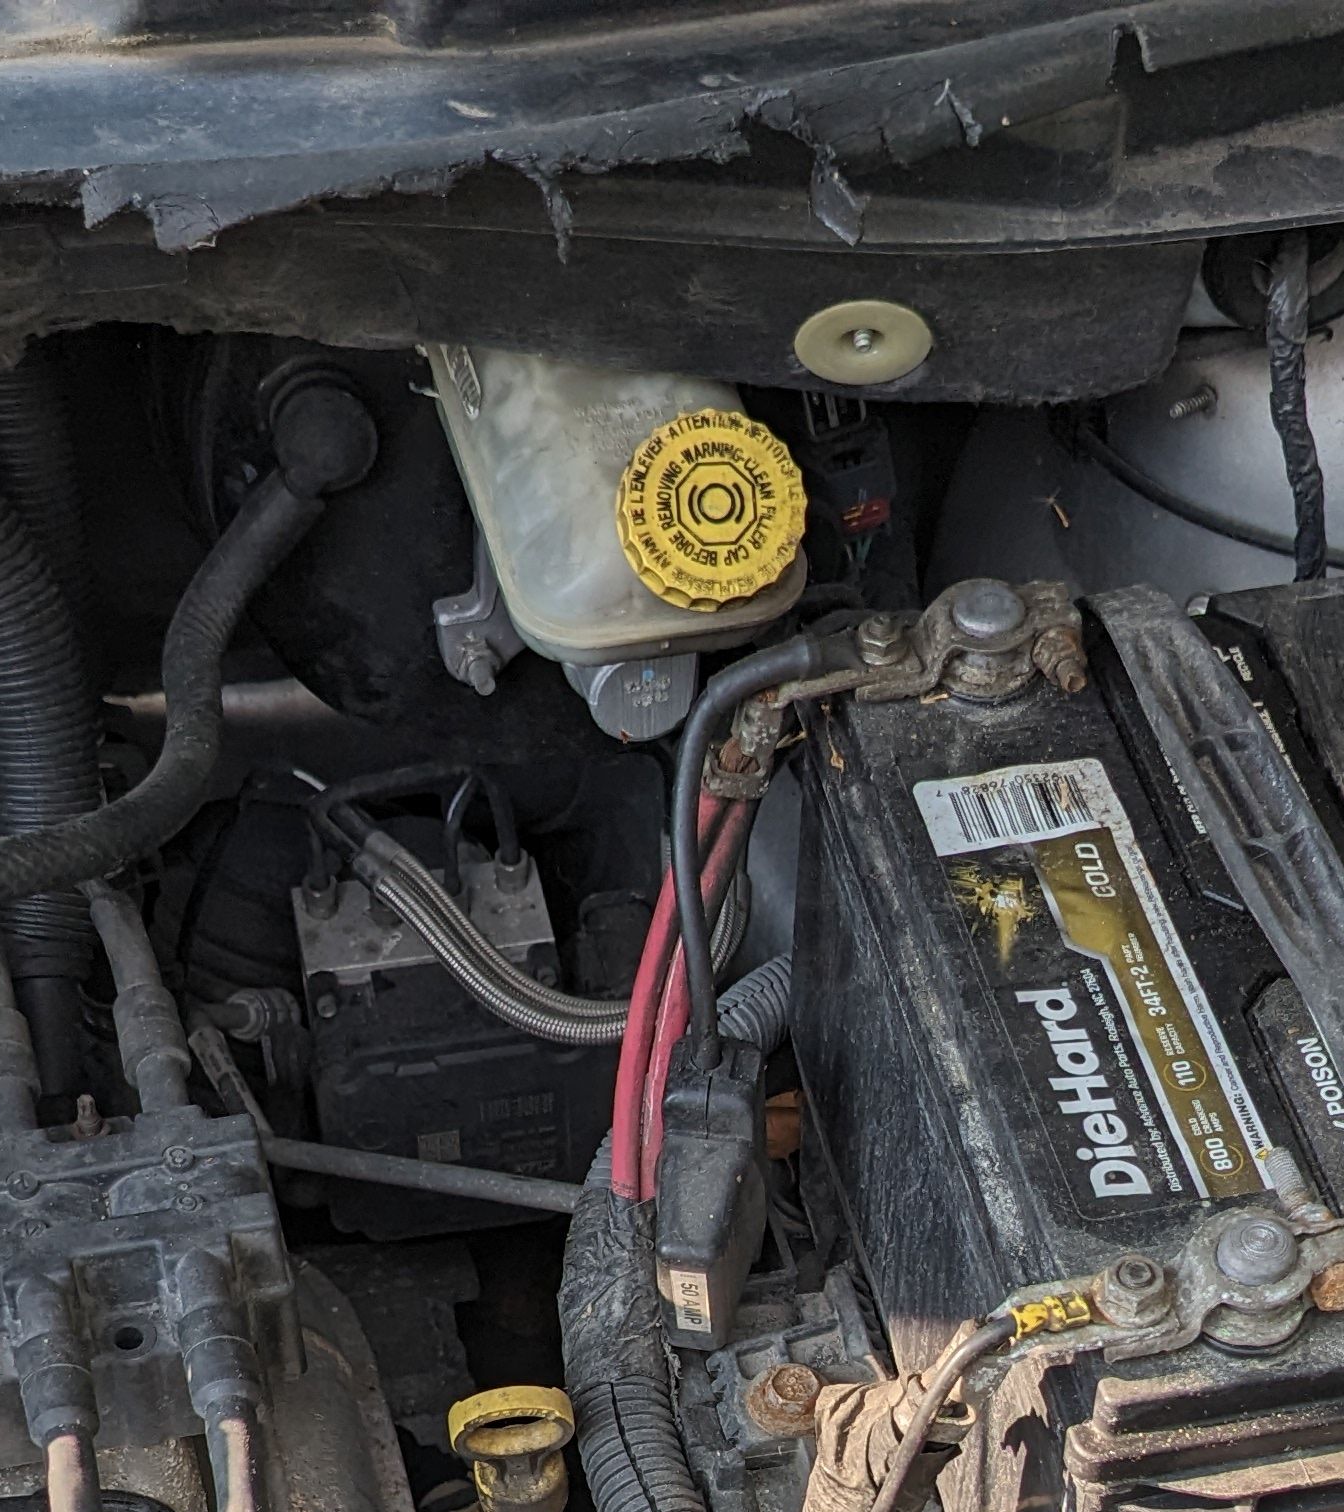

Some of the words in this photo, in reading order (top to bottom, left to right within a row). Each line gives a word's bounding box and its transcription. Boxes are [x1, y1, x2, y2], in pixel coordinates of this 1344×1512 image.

[656, 461, 682, 531] REMOVING
[746, 505, 776, 550] FILLER
[669, 531, 718, 567] BEFORE
[724, 545, 749, 566] CAP
[1072, 844, 1117, 896] GOLD
[1091, 993, 1105, 1005] NC
[1129, 965, 1168, 1015] 34FT-2
[1122, 1069, 1139, 1089] Auto
[1170, 1059, 1197, 1085] 110
[1223, 1068, 1239, 1091] Cancer
[1013, 986, 1153, 1197] DieHard
[1130, 1091, 1155, 1127] Advance
[1232, 1093, 1265, 1149] WARNING:
[1151, 1141, 1182, 1191] Distributed
[1203, 1137, 1233, 1170] 800
[680, 1282, 700, 1297] 50
[682, 1298, 703, 1325] AMP
